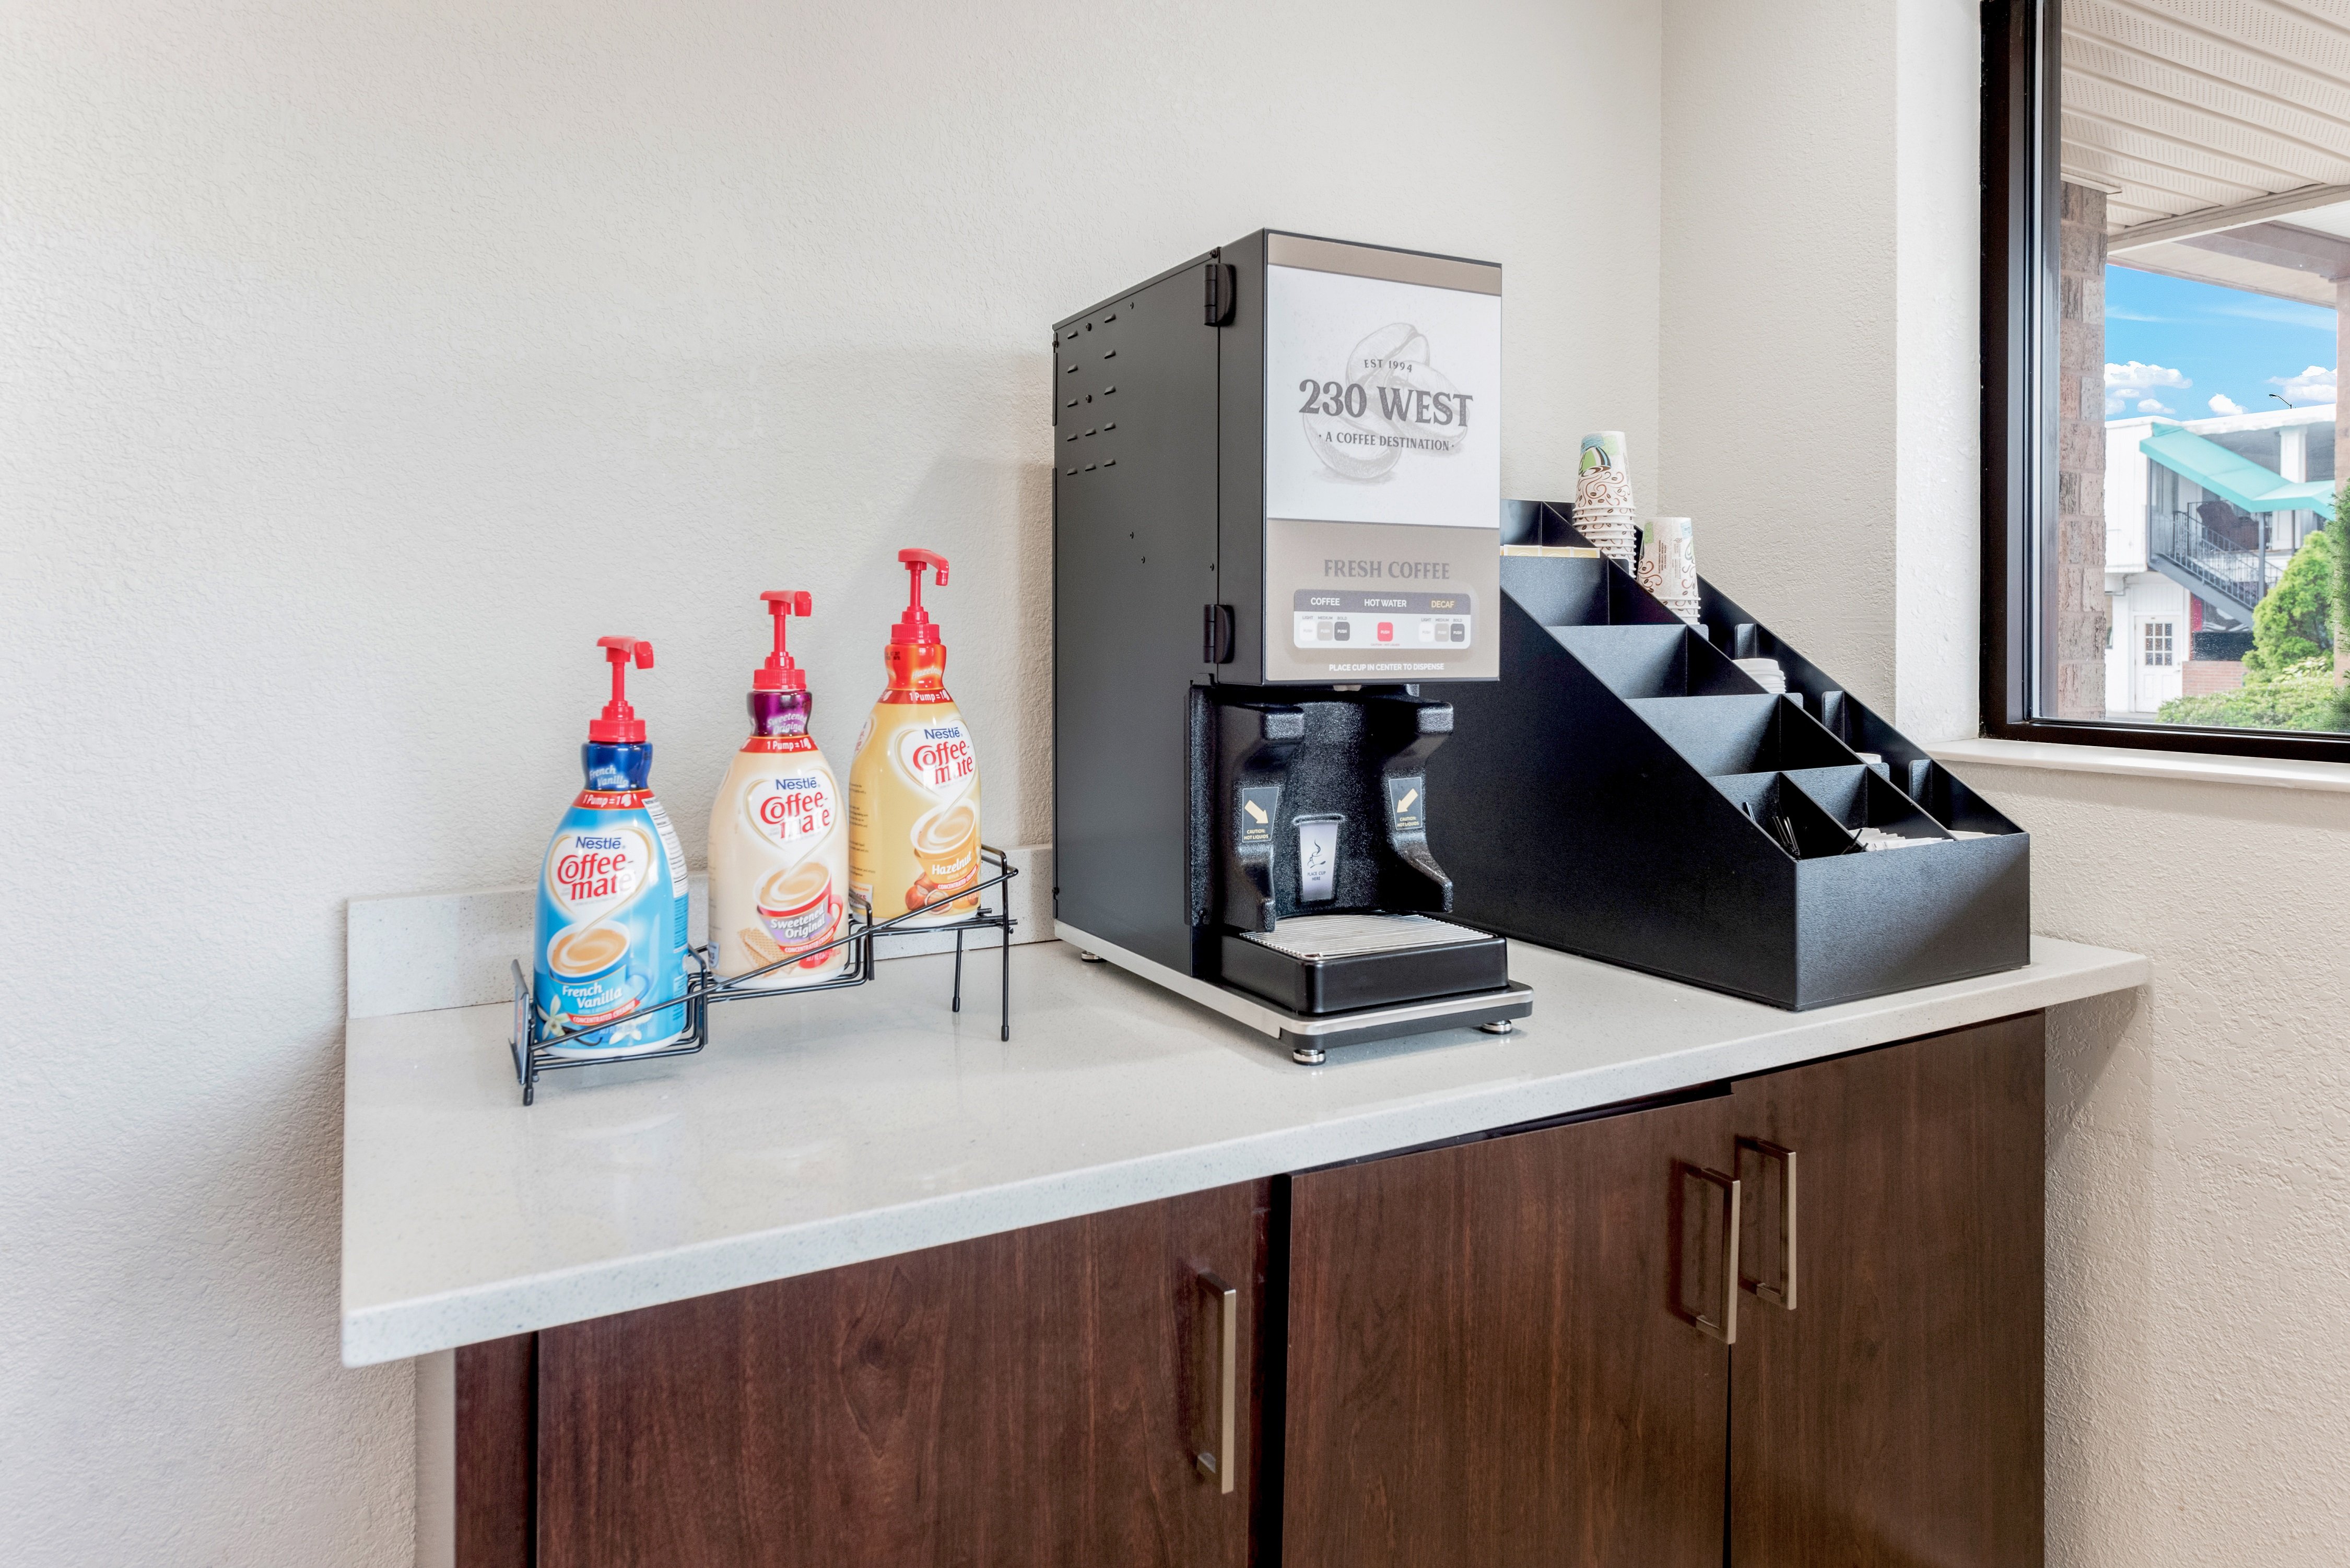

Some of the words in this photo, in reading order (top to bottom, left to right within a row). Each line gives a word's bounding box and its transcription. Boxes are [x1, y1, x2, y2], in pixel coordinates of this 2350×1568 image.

[1364, 359, 1383, 368] EST
[1389, 360, 1413, 372] 1994
[1299, 379, 1367, 418] 230
[1377, 386, 1474, 427] WEST
[1325, 432, 1333, 442] A
[1336, 432, 1376, 446] COFFEE
[1380, 436, 1449, 451] DESTINATION
[1324, 559, 1382, 578] FRESH
[1388, 561, 1450, 580] COFFEE
[1310, 597, 1340, 606] COFFEE
[1431, 600, 1455, 608] DECAF
[914, 692, 935, 703] Pump
[772, 740, 794, 751] Pump
[589, 764, 616, 781] French
[586, 794, 608, 807] Pump
[932, 851, 972, 875] Hazelnut
[770, 902, 825, 929] Sweetened
[785, 914, 825, 938] Original
[562, 982, 603, 997] French
[576, 987, 623, 1009] Vanilla
